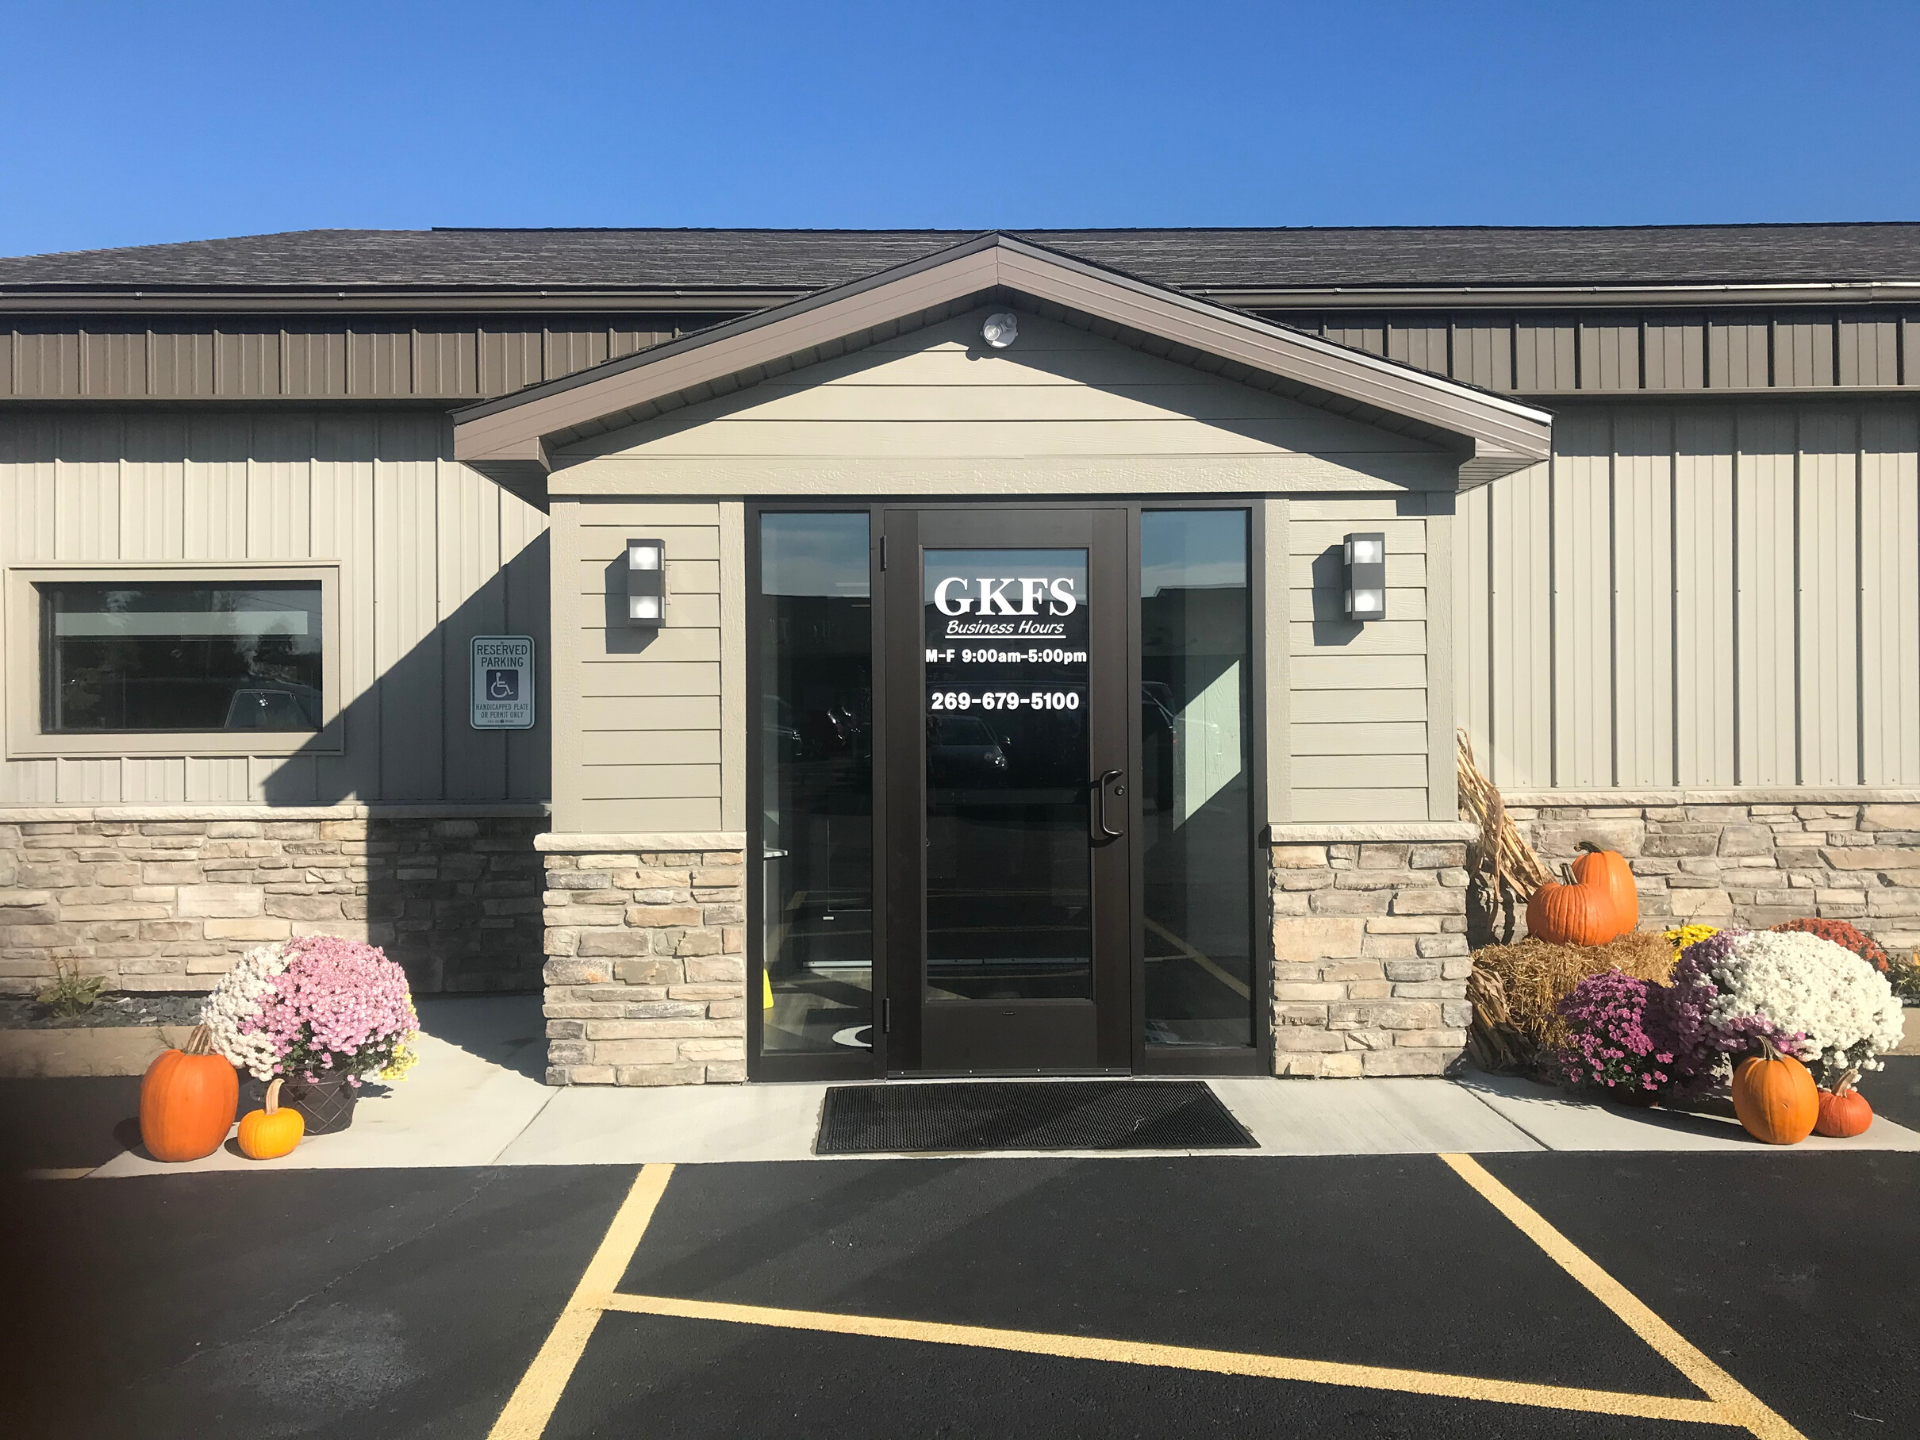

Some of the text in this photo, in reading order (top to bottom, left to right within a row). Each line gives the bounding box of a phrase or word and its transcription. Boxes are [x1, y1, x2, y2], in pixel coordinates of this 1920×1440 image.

[934, 577, 1077, 616] GKFS
[946, 620, 1065, 634] Business Hours
[477, 644, 528, 655] RESERVED
[925, 649, 1087, 665] M-F 9:00am-5:00pm
[481, 657, 524, 667] PARKING
[931, 692, 1080, 710] 269-679-5100
